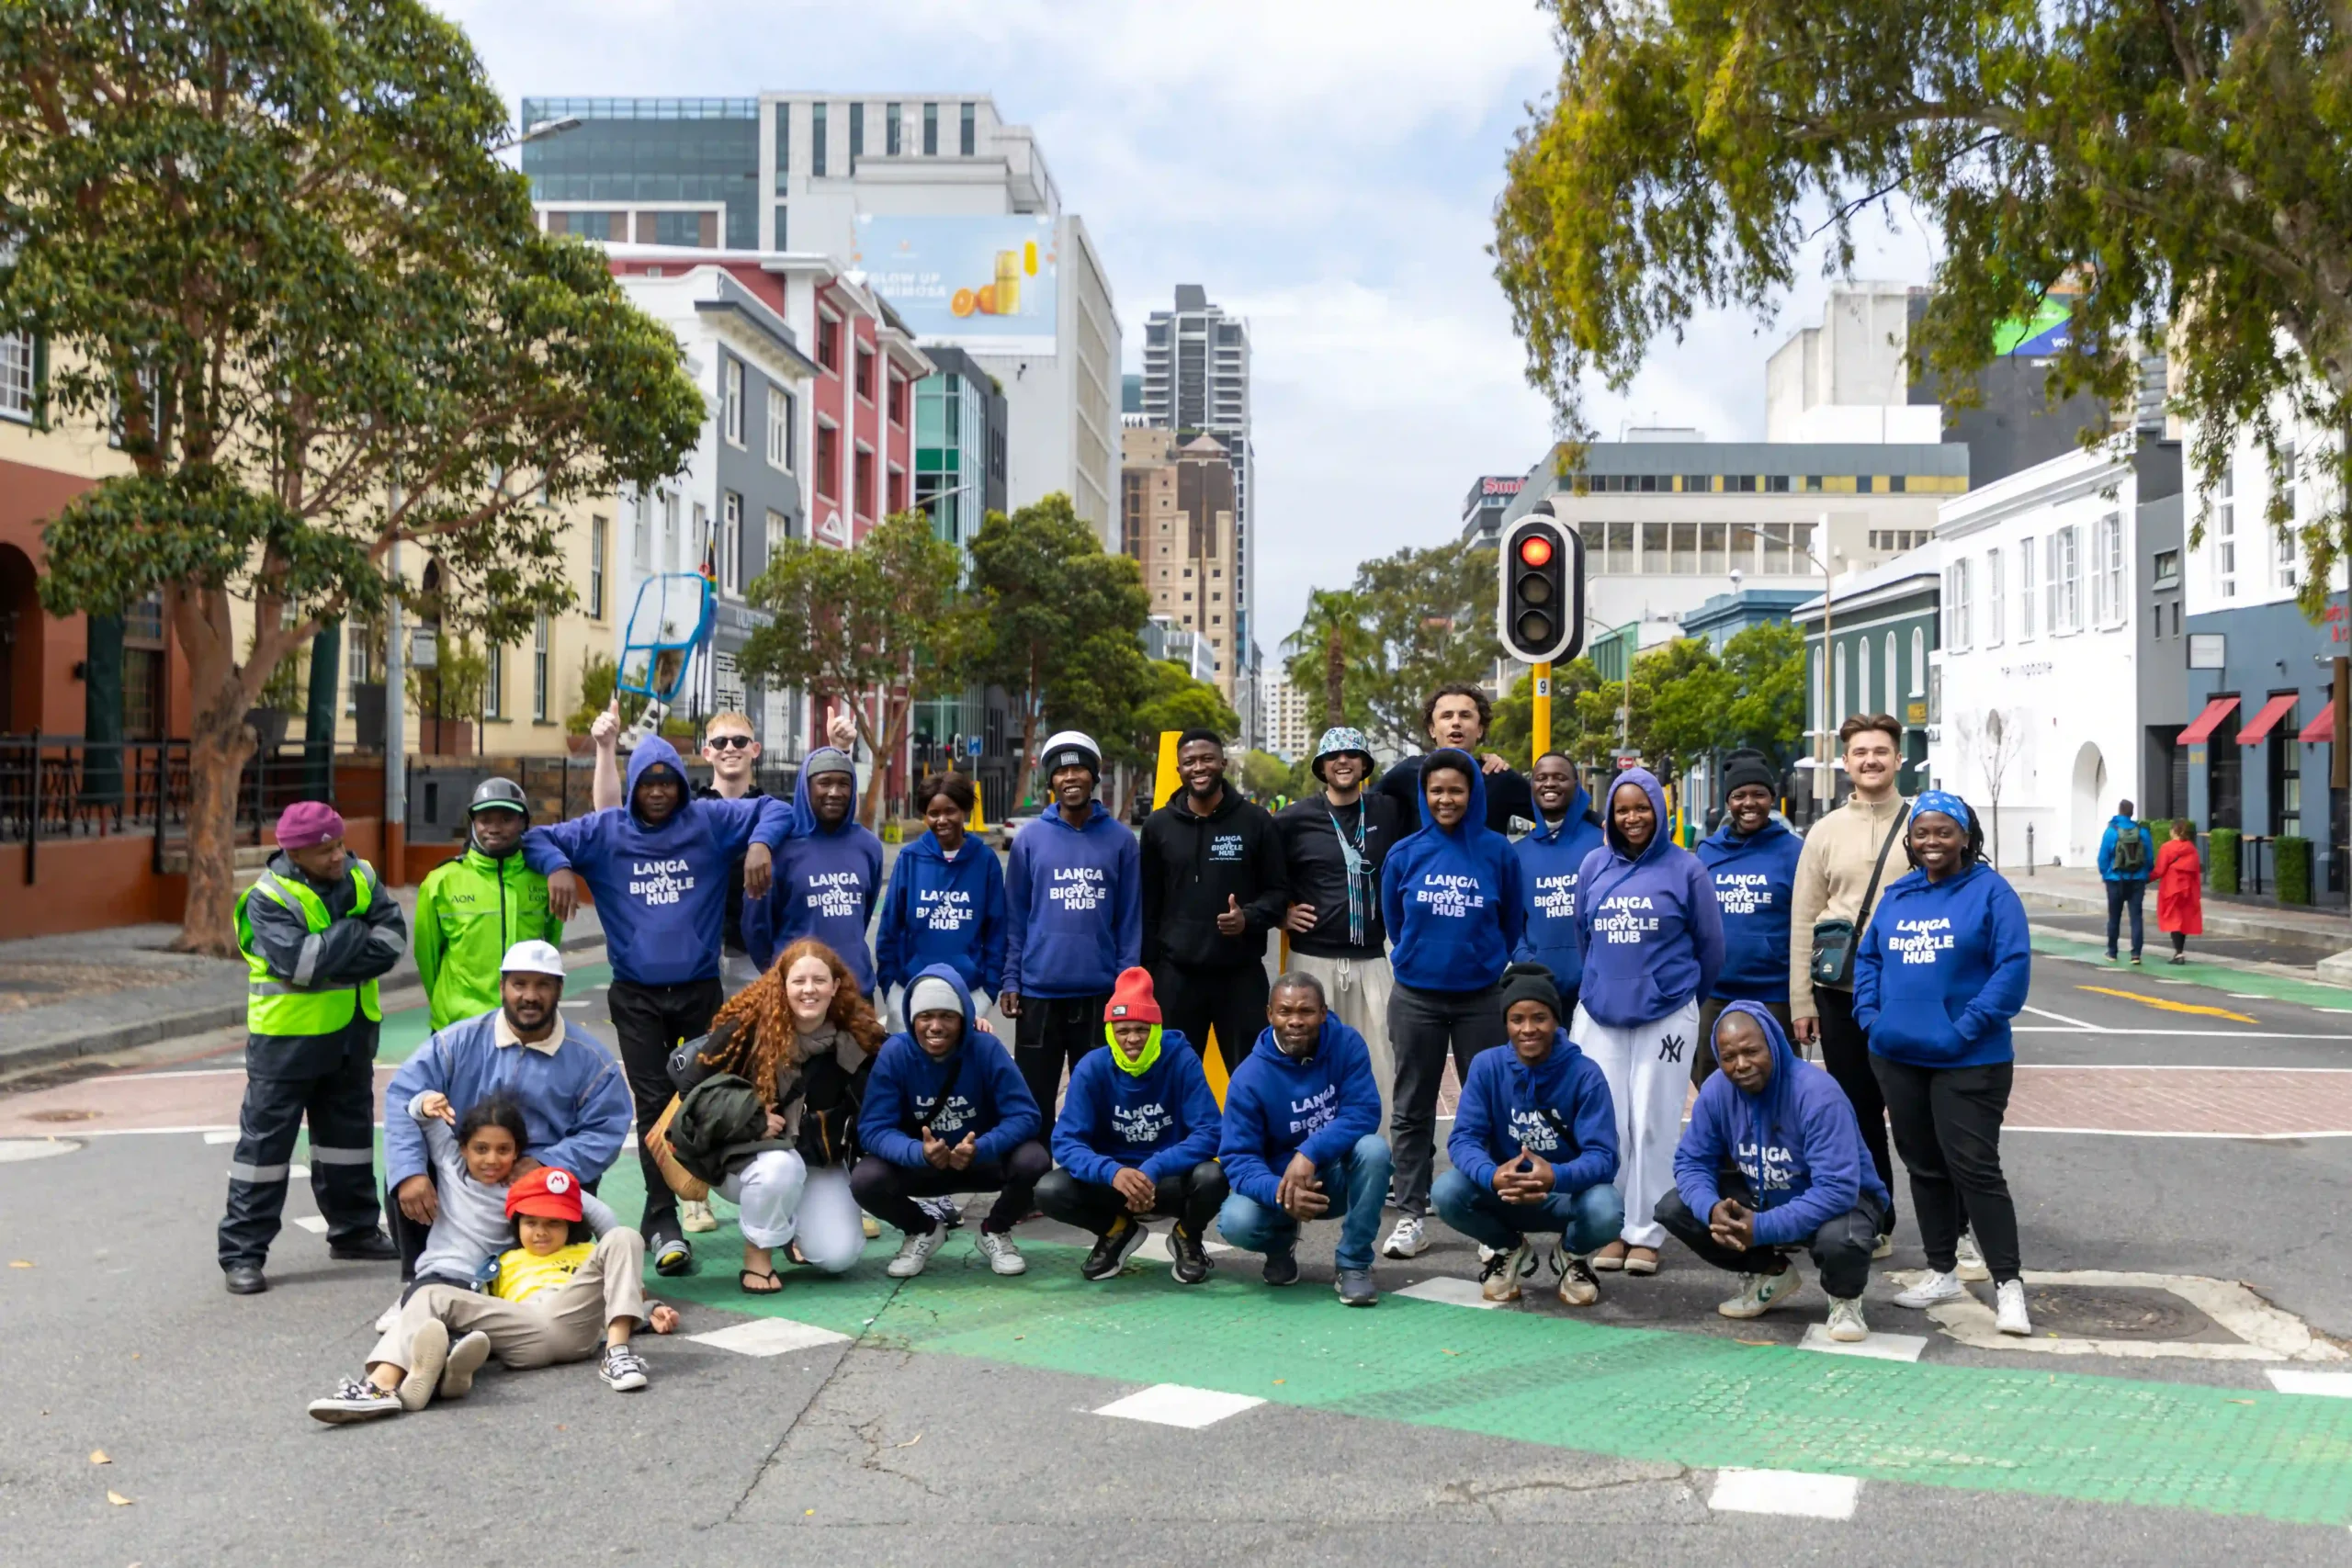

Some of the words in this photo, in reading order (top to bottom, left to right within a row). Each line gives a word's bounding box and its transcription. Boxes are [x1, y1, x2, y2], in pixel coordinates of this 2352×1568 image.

[1540, 681, 1546, 694] 9
[1211, 843, 1243, 852] BICYCLE
[633, 859, 689, 875] LANGA
[808, 872, 860, 887] LANGA
[1054, 868, 1103, 881] LANGA
[1425, 874, 1479, 889] LANGA
[1536, 874, 1578, 888] LANGA
[1716, 874, 1768, 886] LANGA
[629, 876, 695, 895] BICYCLE
[1049, 885, 1106, 899] BICYCLE
[451, 895, 475, 903] AON
[646, 891, 680, 906] HUB
[807, 891, 863, 908] BICYCLE
[920, 889, 970, 903] LANGA
[1417, 890, 1484, 908] BICYCLE
[1534, 893, 1576, 908] BICYC
[822, 904, 853, 918] HUB
[1065, 898, 1096, 910] HUB
[1432, 904, 1465, 918] HUB
[1724, 902, 1756, 914] HUB
[1546, 906, 1574, 919] HUB
[929, 919, 960, 931] HUB
[1594, 915, 1659, 931] BICYCLE
[1896, 918, 1951, 931] LANGA
[1608, 931, 1641, 943] HUB
[1888, 935, 1954, 952] BICYCLE
[1903, 951, 1936, 964] HUB
[916, 1095, 968, 1107] LAGA
[913, 1107, 977, 1122] BYCLE
[1114, 1102, 1165, 1121] LANGA
[1290, 1100, 1338, 1134] BICYC
[930, 1119, 963, 1132] HUB
[1112, 1115, 1173, 1134] BICYCLE
[1125, 1131, 1159, 1143] HUB
[1509, 1123, 1559, 1142] BICYCL
[1738, 1161, 1793, 1182] BIYCL
[551, 1176, 565, 1185] M
